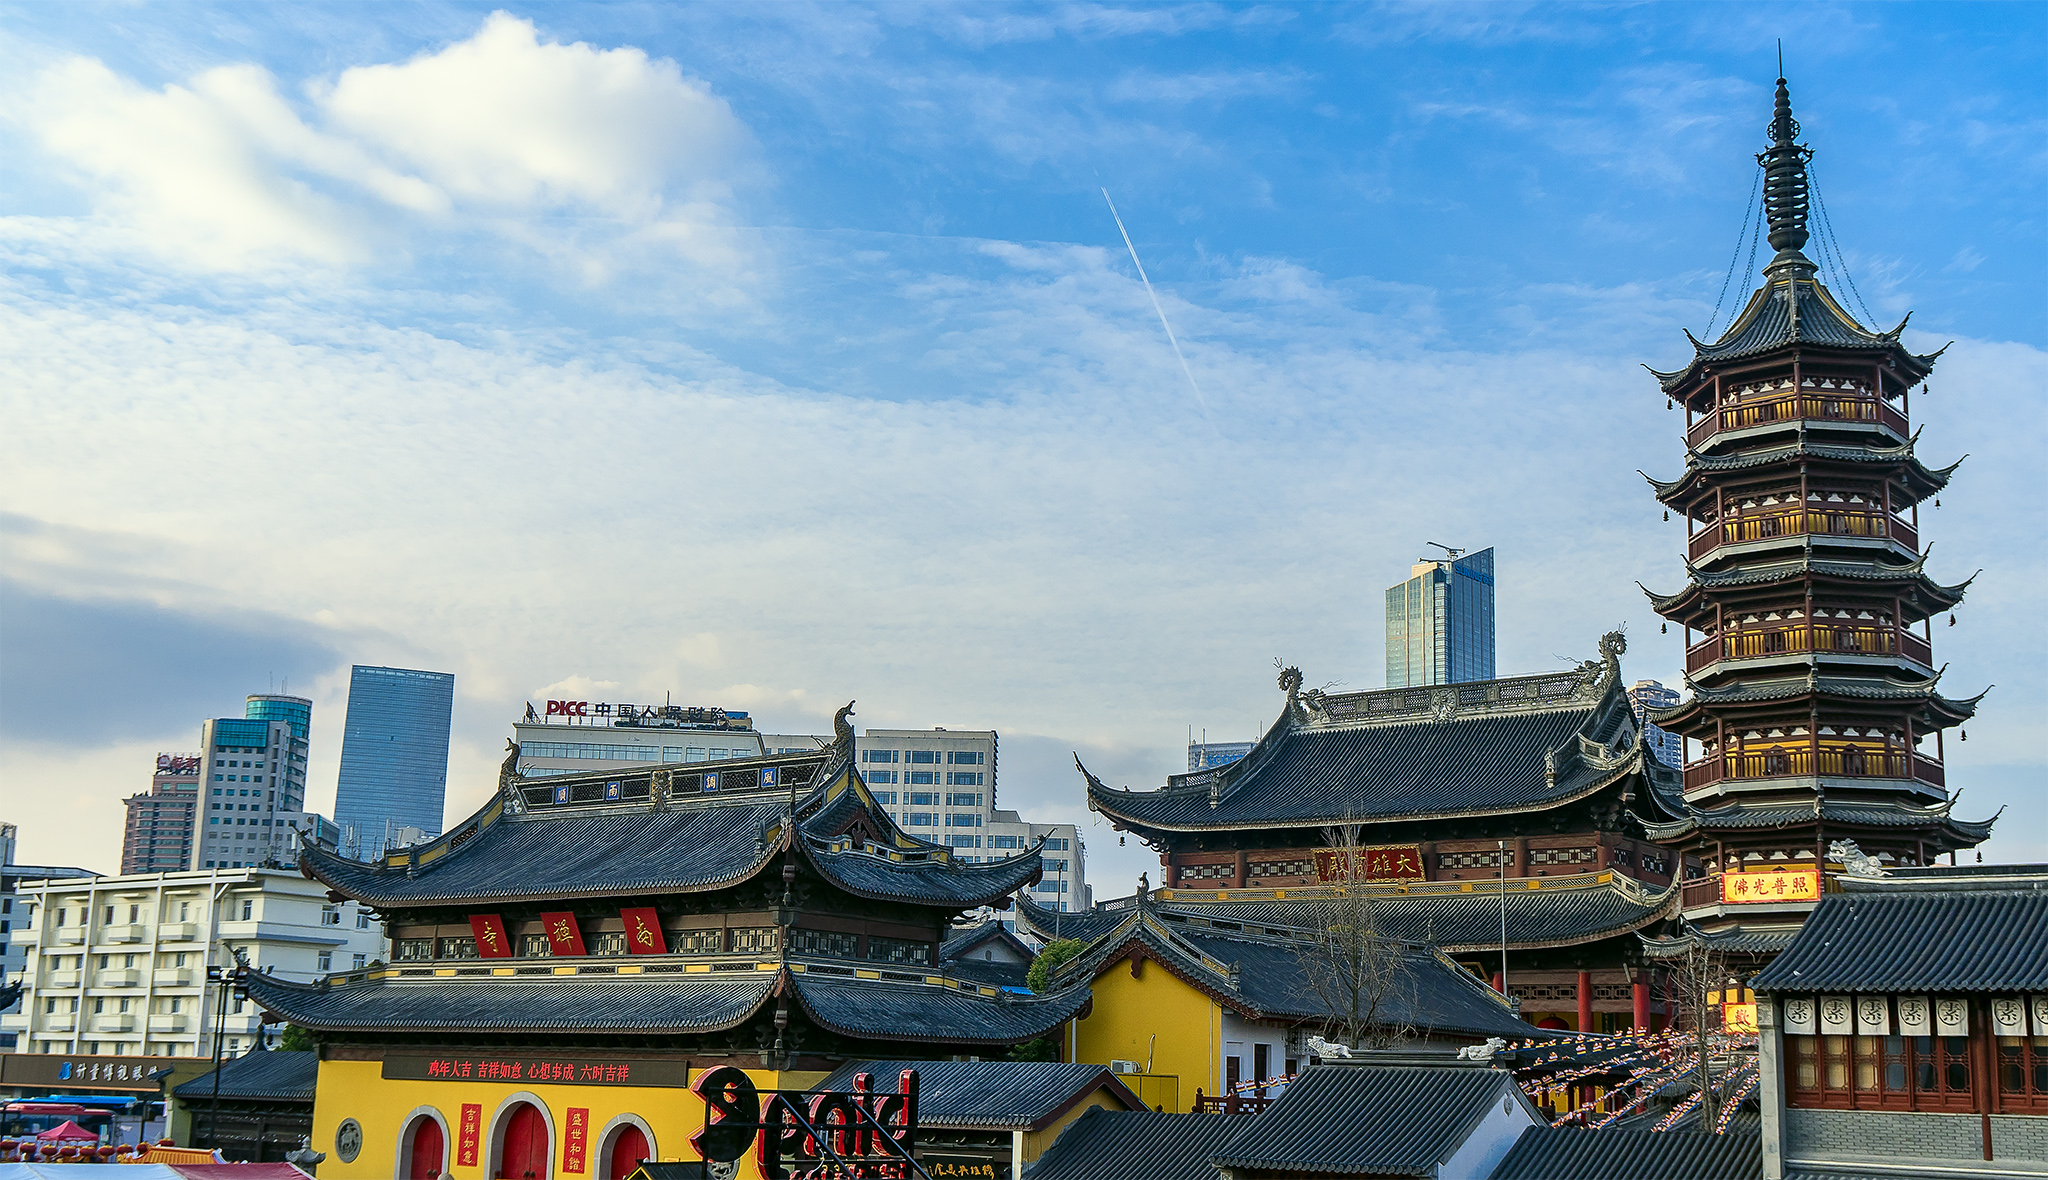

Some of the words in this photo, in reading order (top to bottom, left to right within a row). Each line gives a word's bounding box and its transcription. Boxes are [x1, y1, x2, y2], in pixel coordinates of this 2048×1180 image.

[1455, 564, 1482, 582] SUNING
[546, 700, 587, 716] PICC
[1734, 876, 1808, 896] 佛光普照
[477, 1060, 523, 1079] 吉祥如意
[579, 1063, 630, 1082] 六时吉祥
[462, 1107, 477, 1164] 吉祥如意
